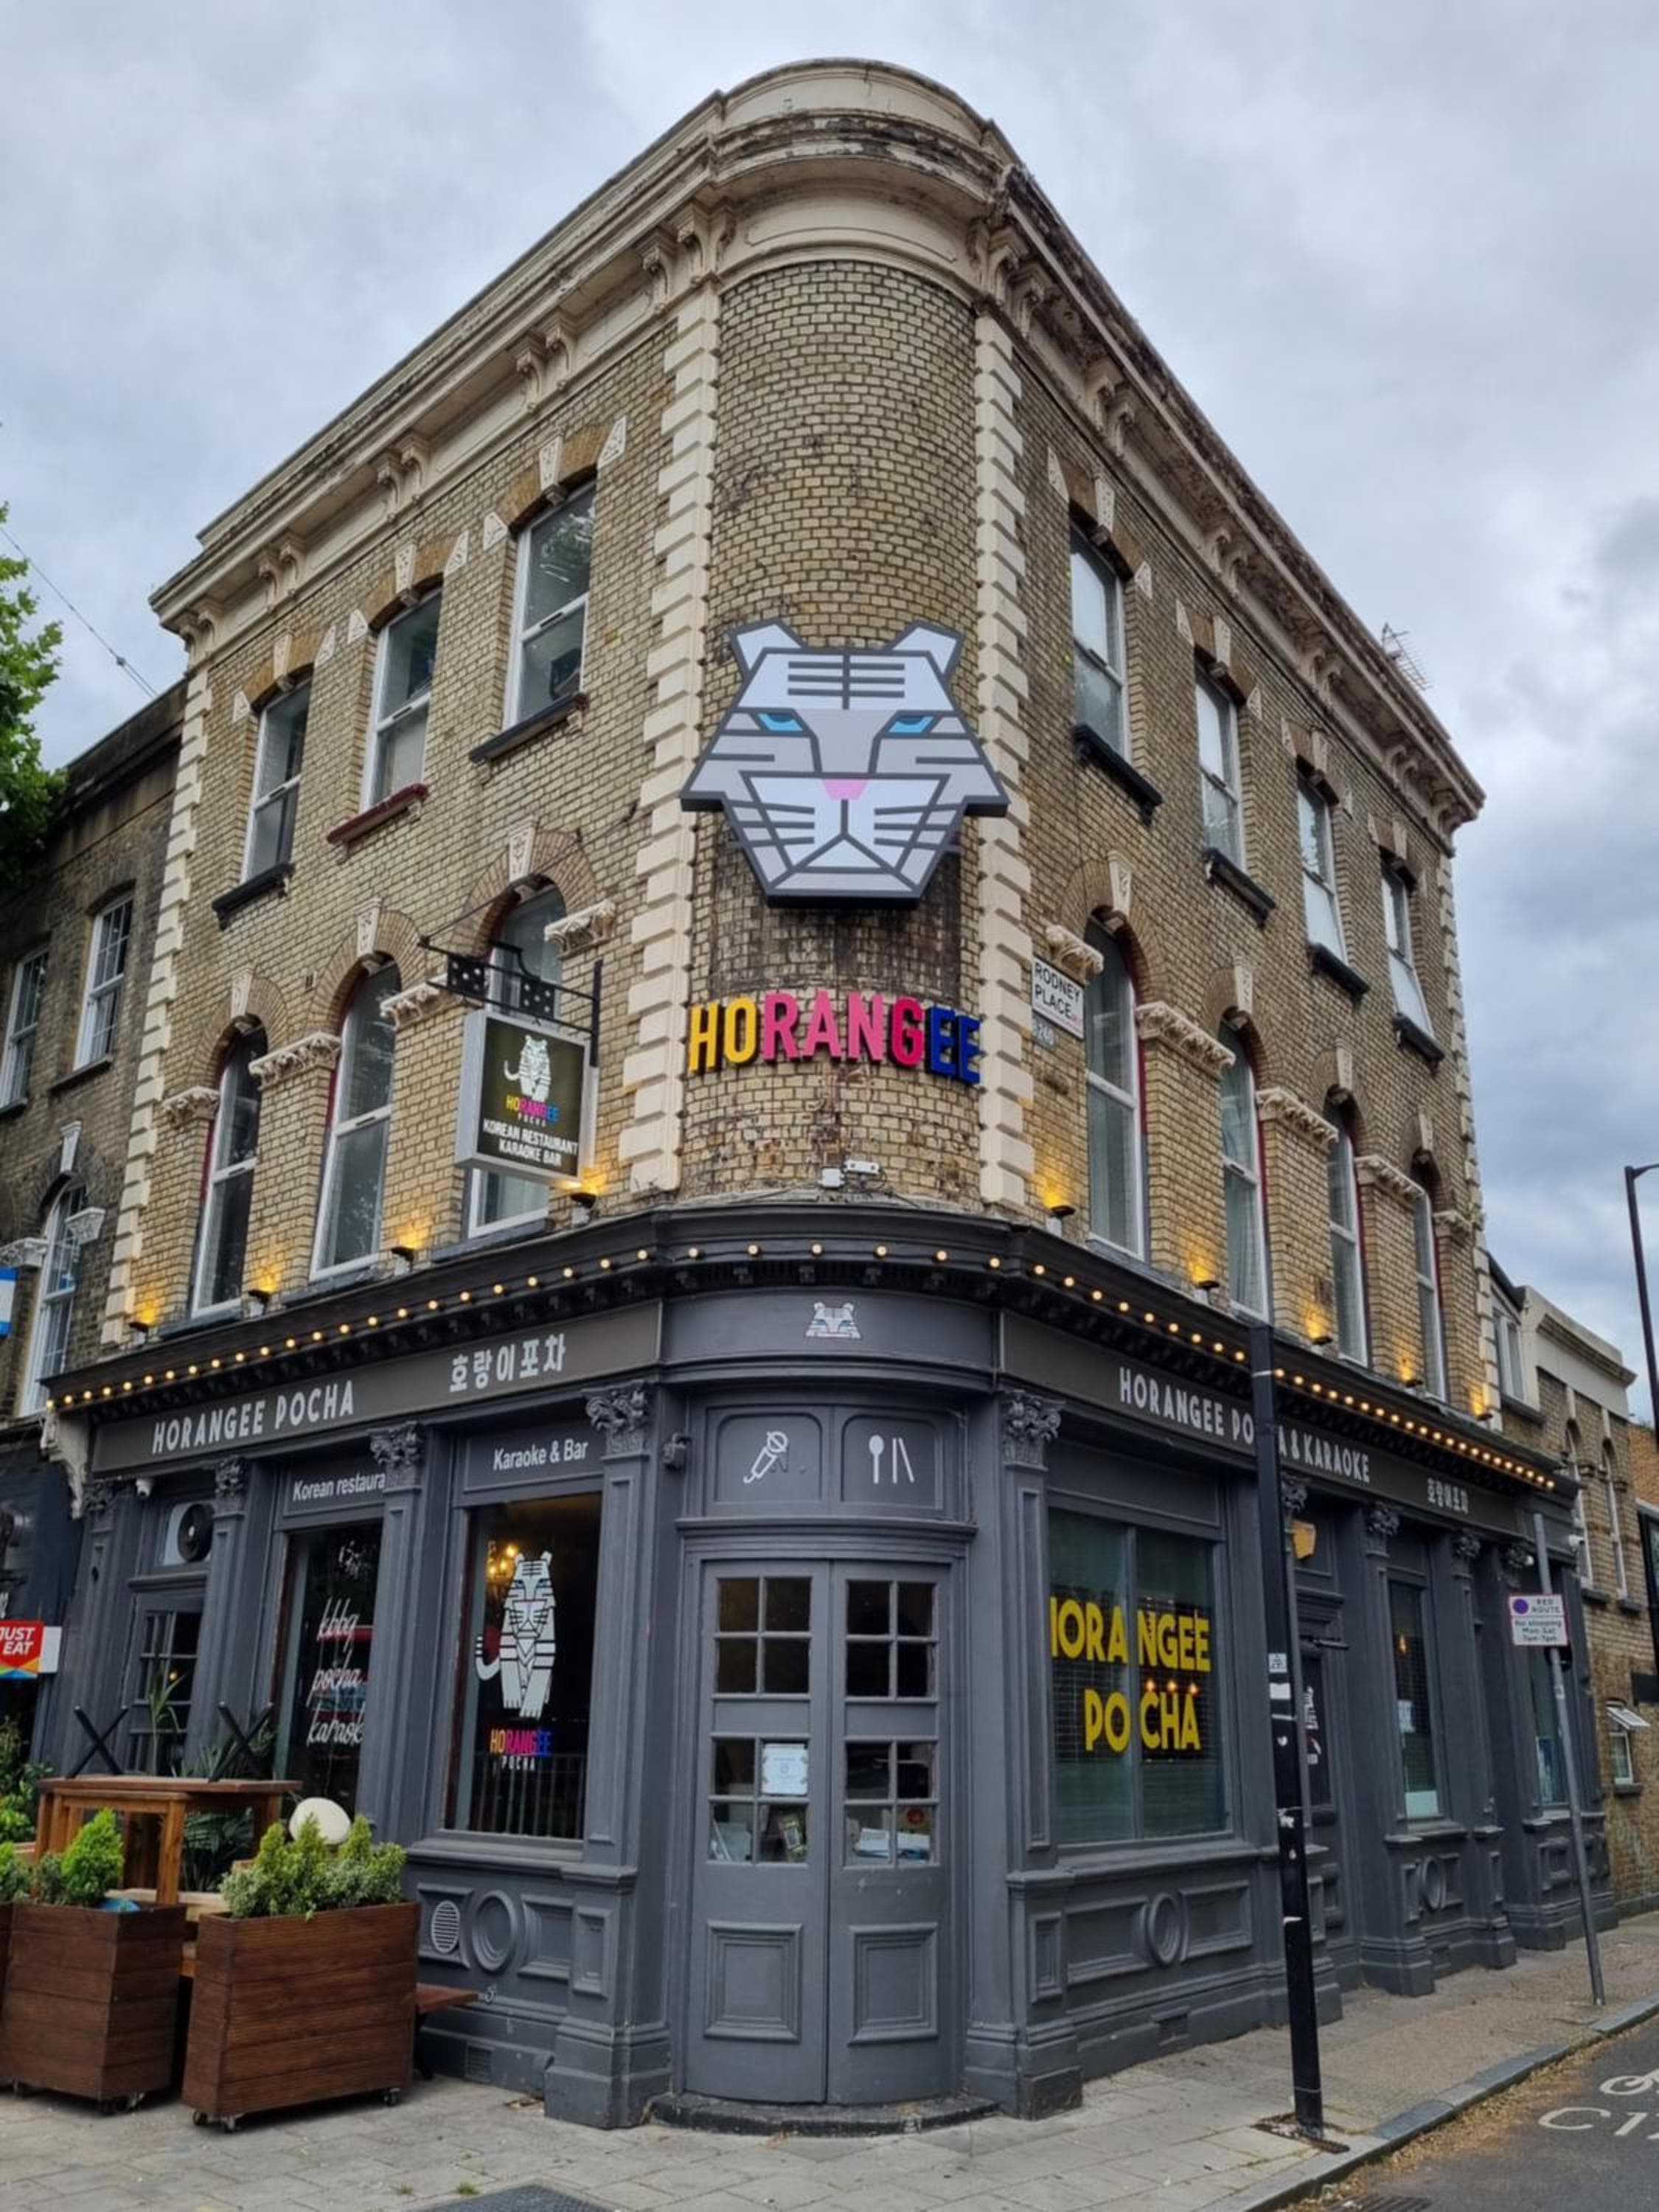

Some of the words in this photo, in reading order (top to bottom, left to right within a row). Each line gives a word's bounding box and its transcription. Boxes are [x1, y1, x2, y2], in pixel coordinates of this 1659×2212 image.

[1035, 962, 1080, 1004] RODNEY
[1035, 984, 1071, 1019] PLACE
[689, 990, 981, 1085] HORANGEE
[505, 1094, 560, 1121] HORANGEE
[483, 1118, 521, 1141] KOREAN
[521, 1128, 579, 1155] RESTAURANT
[498, 1138, 542, 1162] KARAOKE
[543, 1150, 562, 1166] BAR
[450, 1333, 566, 1392] 호랑이포차
[152, 1400, 265, 1455] HORANGEE
[274, 1380, 354, 1430] POCHA
[1119, 1367, 1225, 1436] HORANGEE
[1232, 1408, 1287, 1458] POA
[1290, 1430, 1301, 1460] &
[1303, 1434, 1370, 1484] KARAOKE
[493, 1444, 546, 1471] Karaoke
[549, 1440, 560, 1464] &
[563, 1439, 589, 1461] Bar
[293, 1480, 333, 1502] Korean
[336, 1471, 385, 1495] restaura
[1532, 1606, 1561, 1614] ROUTE
[0, 1627, 36, 1641] JUST
[3, 1641, 34, 1655] EAT
[306, 1700, 366, 1748] karaok
[1085, 1688, 1202, 1753] POCHA
[490, 1729, 552, 1758] HORANGEE
[502, 1755, 535, 1770] POCHA
[1538, 2107, 1659, 2139] C1
